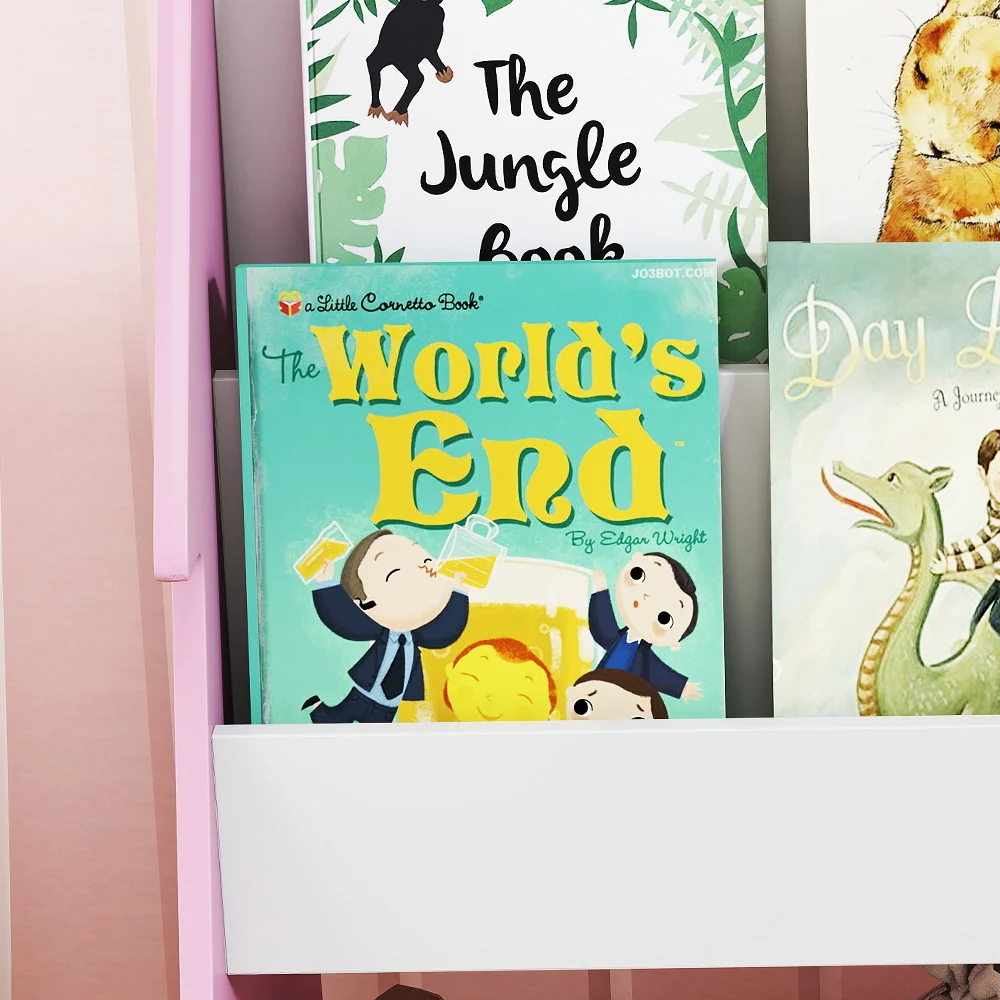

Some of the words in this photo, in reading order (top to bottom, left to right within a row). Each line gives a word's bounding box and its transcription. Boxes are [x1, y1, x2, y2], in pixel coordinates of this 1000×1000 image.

[473, 54, 578, 120] The
[420, 120, 641, 222] Jungle
[305, 303, 314, 313] a
[317, 293, 358, 313] Little
[361, 292, 436, 313] Cornetto
[632, 267, 713, 280] JO3BOT.COM
[262, 345, 320, 385] The
[310, 320, 706, 405] World's
[782, 283, 926, 402] Day
[932, 389, 949, 412] A
[366, 408, 674, 529] End
[565, 530, 595, 554] By
[600, 530, 650, 554] Edgar
[652, 528, 707, 553] Wright
